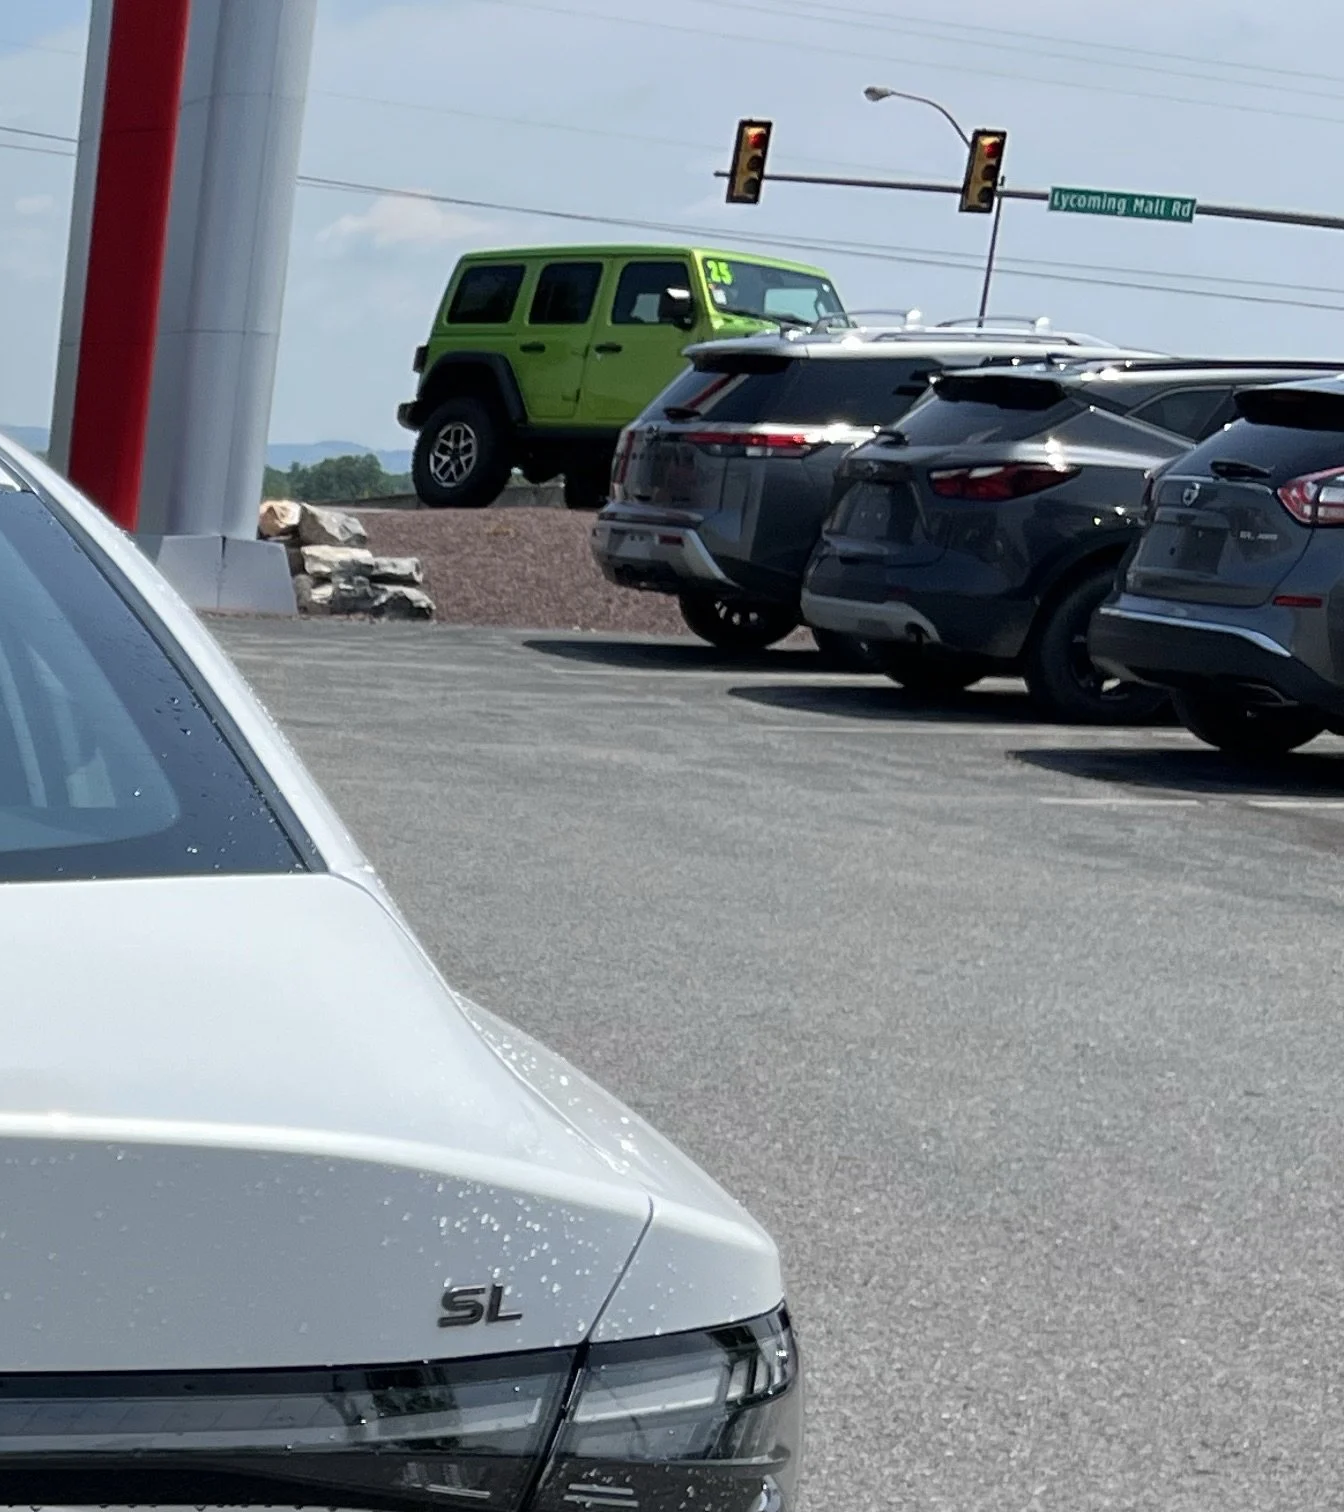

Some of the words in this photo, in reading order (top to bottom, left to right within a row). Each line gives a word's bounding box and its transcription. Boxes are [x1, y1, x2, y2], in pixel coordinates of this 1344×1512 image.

[1053, 190, 1127, 215] Lycoming
[1133, 197, 1166, 215] Mall
[1171, 200, 1192, 217] Rd
[707, 260, 733, 285] 25
[437, 1283, 523, 1328] SL
